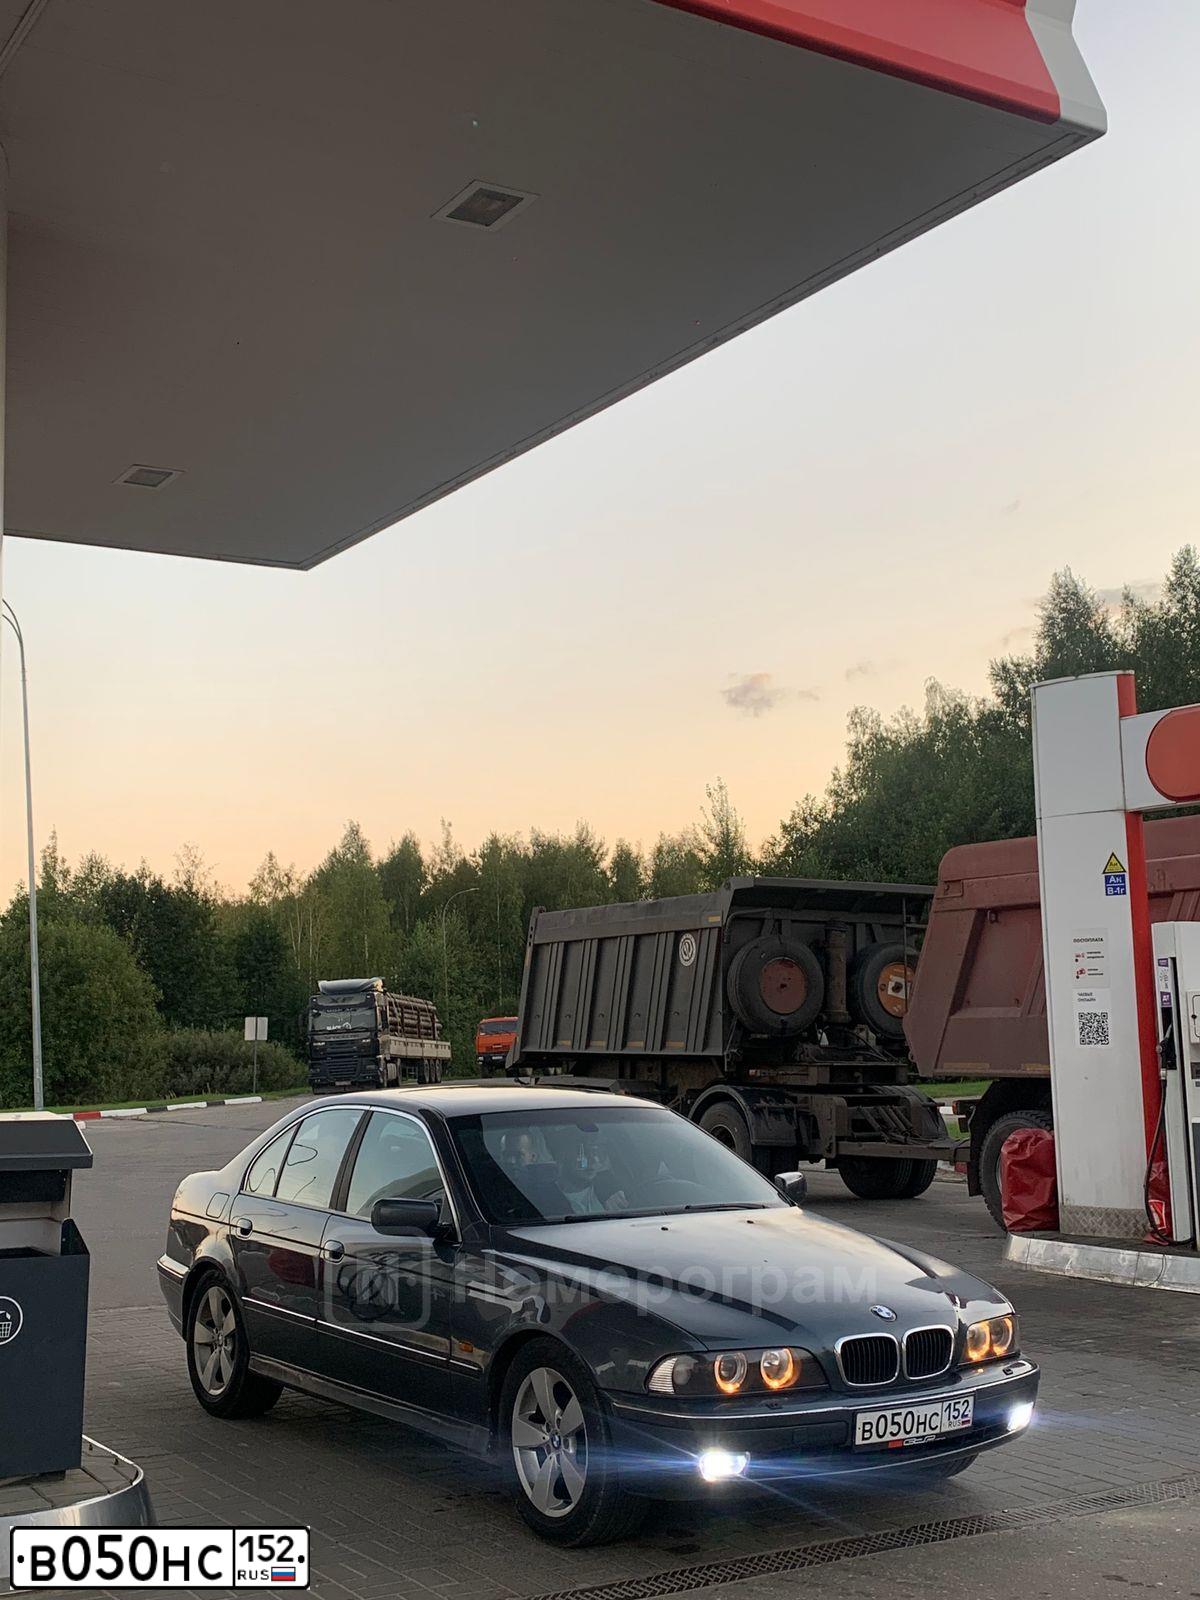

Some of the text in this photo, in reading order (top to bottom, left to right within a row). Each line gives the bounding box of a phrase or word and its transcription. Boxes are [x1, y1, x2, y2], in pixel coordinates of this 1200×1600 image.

[861, 1410, 940, 1442] В050НС
[944, 1399, 970, 1421] 152
[947, 1420, 961, 1428] RUS
